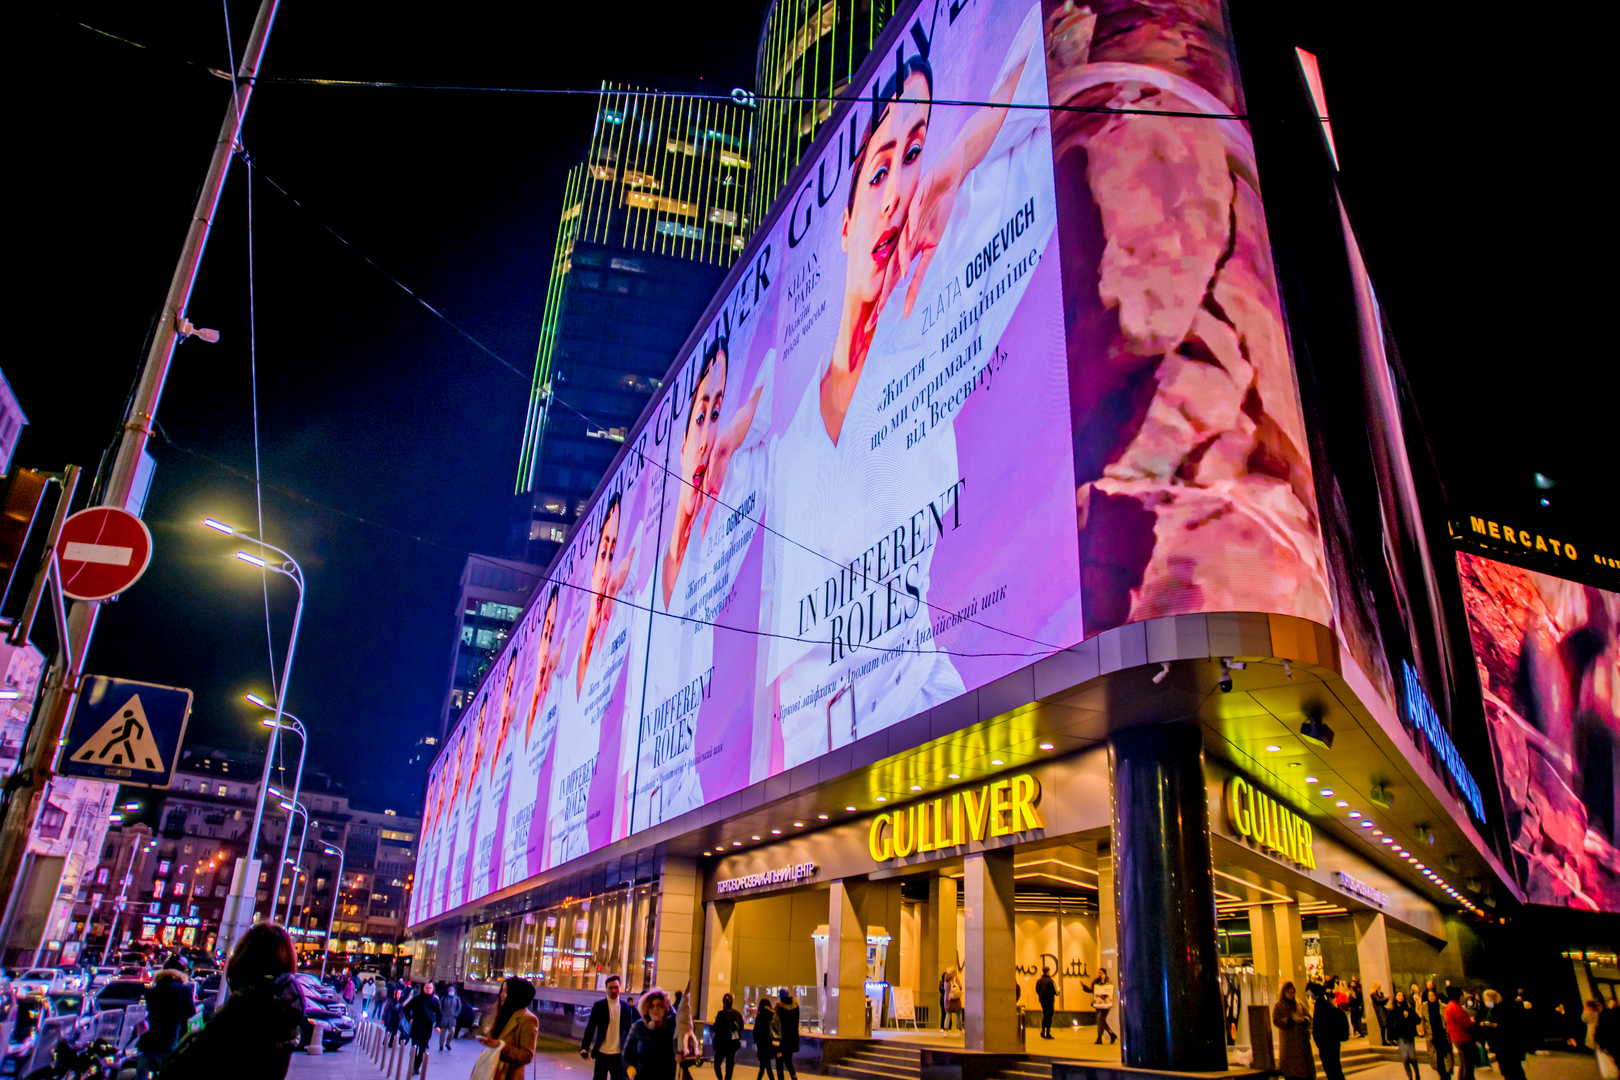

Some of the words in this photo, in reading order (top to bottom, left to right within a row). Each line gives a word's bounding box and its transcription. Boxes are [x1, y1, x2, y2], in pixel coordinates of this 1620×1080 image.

[794, 264, 821, 313] PARIS
[921, 276, 962, 336] ZLATA
[965, 196, 1036, 288] OGNEVICH
[656, 243, 771, 447] GULLIVER
[876, 356, 926, 413] «Життя
[941, 247, 1043, 354] найцінніше,
[870, 426, 888, 451] що
[890, 408, 909, 433] ми
[911, 334, 983, 412] отримали
[906, 417, 927, 451] від
[930, 344, 1009, 430] Всесвіту!»
[797, 588, 819, 637] IN
[823, 477, 966, 620] DIFFERENT
[1470, 515, 1578, 561] MERCATO
[828, 561, 920, 666] ROLES
[844, 656, 879, 688] Аромат
[981, 584, 1007, 610] шик
[641, 712, 653, 743] IN
[653, 666, 715, 735] DIFFERENT
[653, 714, 694, 769] ROLES
[869, 773, 1043, 862] GULLIVER
[1231, 775, 1317, 870] GULLIVER
[717, 864, 791, 894] ТОРГОВО-РОЗВАЖАЛЬНИЙ
[792, 861, 815, 882] ЦЕНТР
[1039, 952, 1090, 978] Dutti
